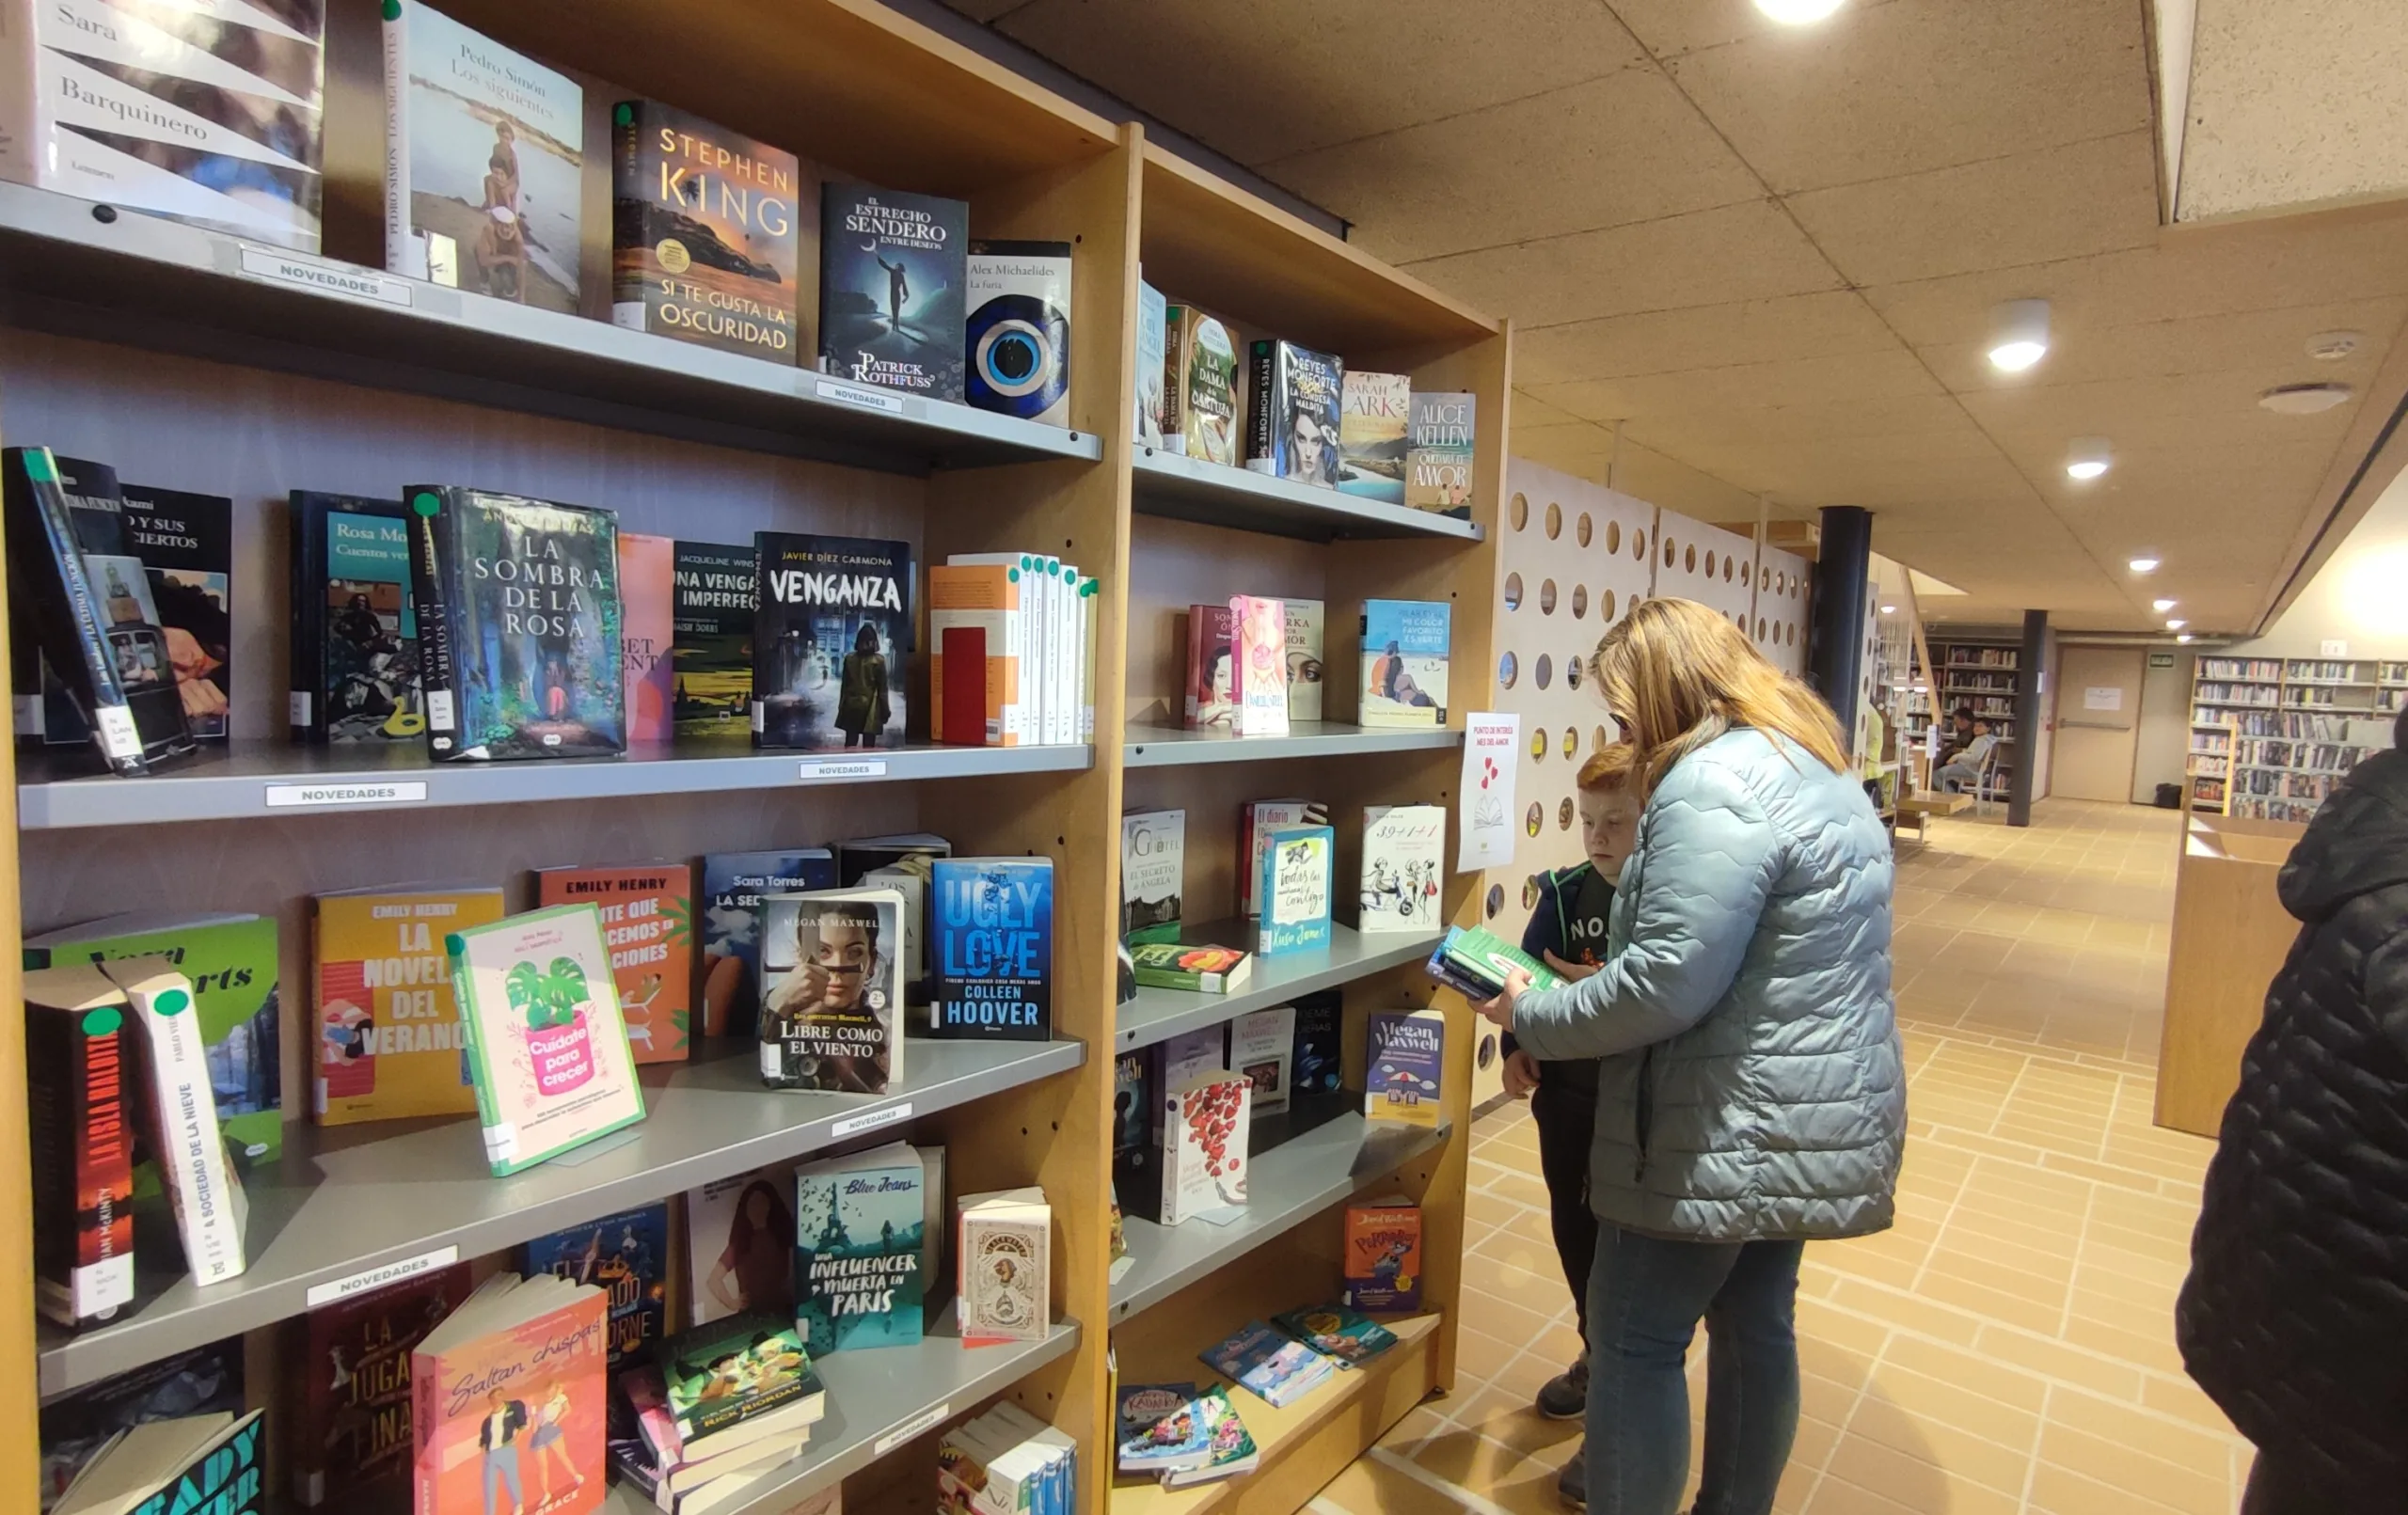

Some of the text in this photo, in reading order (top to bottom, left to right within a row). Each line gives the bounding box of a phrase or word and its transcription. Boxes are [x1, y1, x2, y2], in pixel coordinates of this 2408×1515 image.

[57, 3, 118, 42] Sara
[460, 43, 546, 98] Pedro Simón
[452, 58, 555, 120] Los siguientes
[61, 75, 208, 141] Barquinero
[659, 128, 787, 192] STEPHEN
[660, 161, 788, 236] KING
[867, 197, 879, 206] EL
[388, 193, 399, 235] PEDRO
[855, 204, 931, 224] ESTRECHO
[847, 215, 946, 243] SENDERO
[879, 235, 943, 251] ENTRE DESEOS
[280, 263, 380, 295] NOVEDADES
[970, 263, 1055, 276] Alex Michaelides
[970, 279, 1002, 290] La furia
[661, 279, 786, 325] SI TE GUSTA LA
[659, 303, 787, 350] OSCURIDAD
[858, 350, 924, 376] PATRICK
[1207, 355, 1219, 371] LA
[1299, 357, 1326, 374] REYES
[851, 363, 936, 389] ROTHFUSS
[1199, 368, 1226, 390] DAMA
[1287, 368, 1336, 391] MONFORTE
[834, 388, 886, 408] NOVEDADES
[1259, 358, 1270, 444] REYES MONFORTE
[1290, 387, 1331, 405] LA CONDESA
[1348, 383, 1387, 396] SARAH
[1296, 399, 1324, 415] MALDITA
[1343, 395, 1398, 418] ARK
[1419, 404, 1466, 425] ALICE
[1417, 425, 1468, 447] KELLEN
[1413, 466, 1466, 487] AMOR
[139, 517, 185, 533] Y SUS
[336, 523, 408, 543] Rosa Mo
[336, 544, 388, 560] Cuentos
[525, 536, 560, 560] LA
[782, 551, 893, 566] JAVIER DÍEZ CARMONA
[679, 555, 754, 568] JACQUELINE WINS
[475, 558, 604, 590] SOMBRA
[673, 570, 755, 592] NA VENGA
[506, 586, 583, 612] DE LA
[683, 591, 754, 609] IMPERFEC
[769, 569, 902, 613] VENGANZA
[506, 613, 584, 638] ROSA
[1286, 618, 1309, 628] RKA
[420, 604, 436, 682] DE LA ROSA
[434, 604, 449, 682] LA SOMBRA
[1473, 726, 1489, 734] PUNTO
[818, 765, 870, 776] NOVEDADES
[302, 786, 396, 801] NOVEDADES
[1259, 808, 1289, 824] El diario
[566, 878, 667, 893] EMILY HENRY
[733, 876, 805, 887] Sara Torres
[372, 904, 458, 919] EMILY HENRY
[628, 898, 659, 919] QUE
[716, 894, 733, 907] LA
[944, 879, 1042, 928] UGLY
[607, 922, 659, 946] CEMOS
[784, 918, 885, 928] MEGAN MAXWELL
[1570, 917, 1610, 940] NO
[399, 923, 433, 953] LA
[611, 942, 668, 970] CIONES
[944, 929, 1041, 978] LOVE
[195, 965, 252, 994] rts
[363, 955, 452, 988] NOVEL
[392, 990, 439, 1019] DEL
[964, 986, 1022, 1000] COLLEEN
[947, 1001, 1038, 1026] HOOVER
[361, 1021, 467, 1055] VERANO
[780, 1020, 883, 1042] LIBRE COMO
[1380, 1021, 1434, 1038] Megan
[171, 1037, 184, 1063] PABLO
[530, 1027, 588, 1056] Cuídate
[791, 1041, 873, 1058] EL VIENTO
[1375, 1033, 1439, 1052] Maxwell
[545, 1047, 580, 1073] para
[542, 1059, 590, 1088] crecer
[179, 1082, 198, 1121] NIEVE
[188, 1122, 200, 1140] LA
[849, 1110, 897, 1130] NOVEDADES
[87, 1099, 122, 1166] LA ISLA
[189, 1140, 203, 1157] DE
[194, 1160, 214, 1218] SOCIEDAD
[843, 1176, 918, 1195] Blue Jeans
[98, 1188, 113, 1238] McKINTY
[340, 1257, 430, 1293] NOVEDADES
[809, 1254, 917, 1280] INFLUENCER
[824, 1274, 904, 1293] MUERTA EN
[364, 1318, 391, 1352] LA
[344, 1350, 410, 1408] JUGA
[448, 1320, 601, 1418] Saltan chispas
[704, 1383, 801, 1428] RICK RIORDAN
[889, 1414, 936, 1444] NOVEDADES
